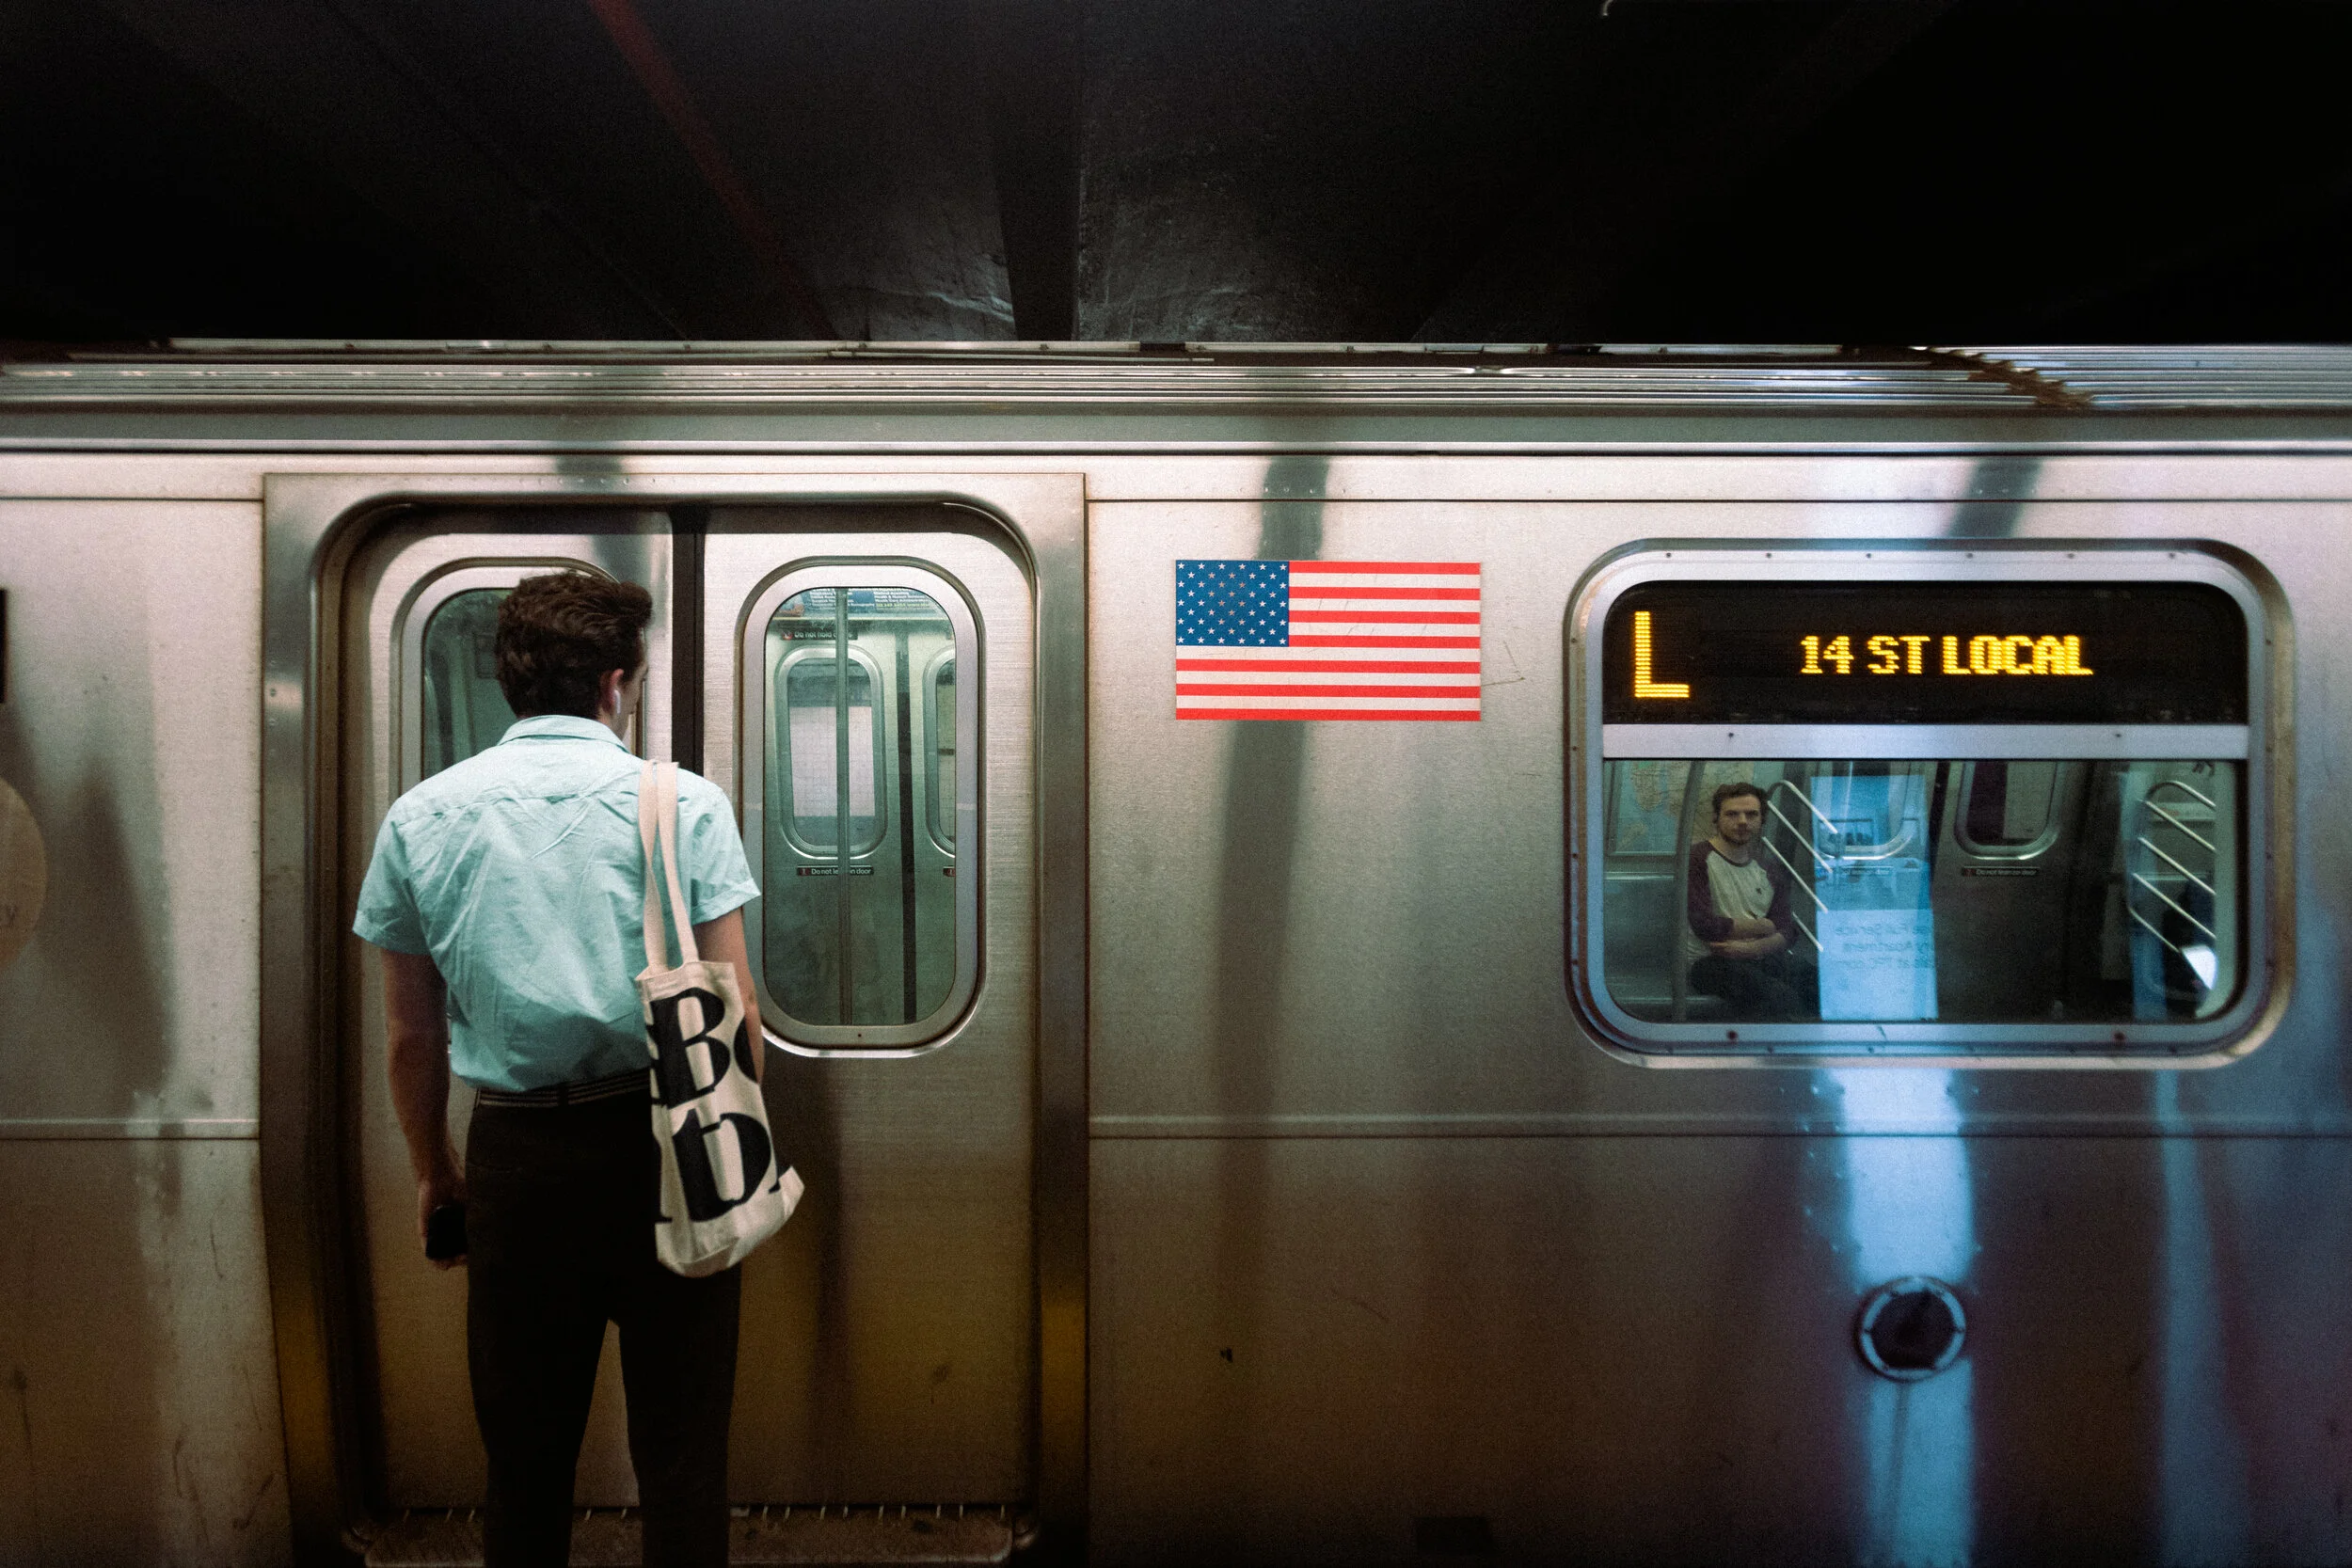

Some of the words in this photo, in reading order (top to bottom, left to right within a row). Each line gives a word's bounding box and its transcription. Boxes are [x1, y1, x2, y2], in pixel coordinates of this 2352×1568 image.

[1635, 611, 1690, 698] L
[1801, 635, 1854, 674] 14
[1867, 635, 1931, 674] ST
[1942, 635, 2094, 675] LOCAL
